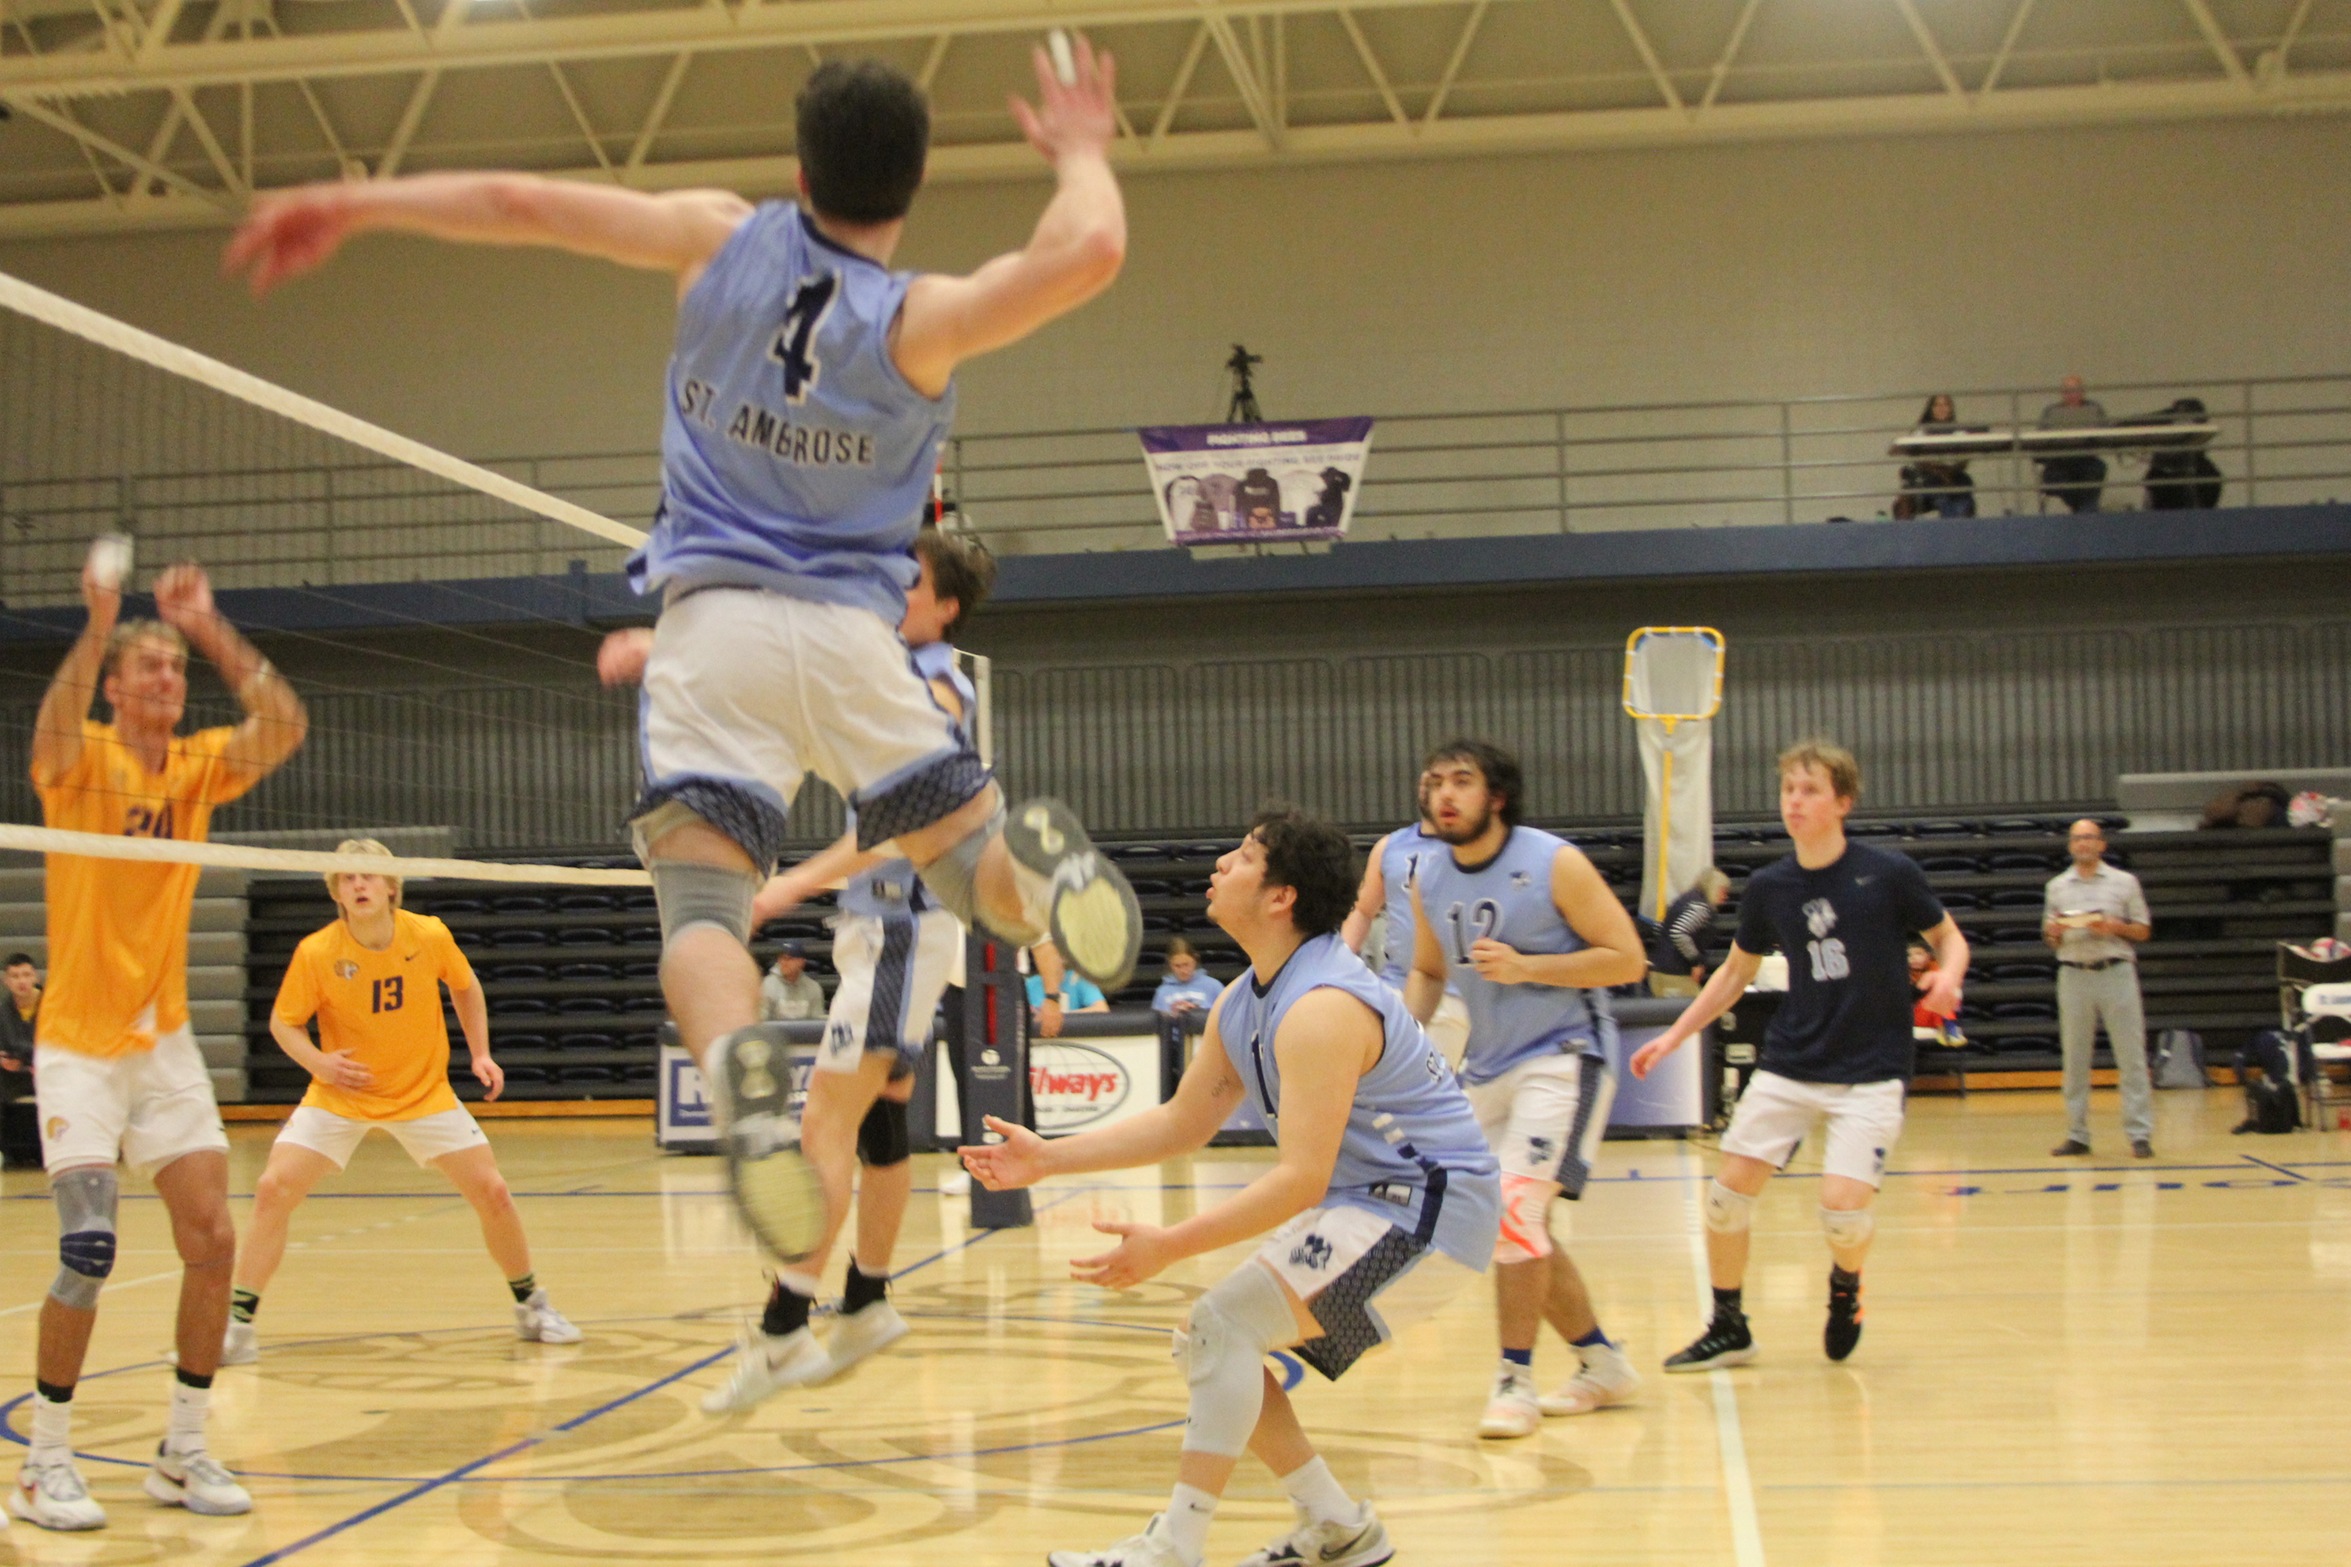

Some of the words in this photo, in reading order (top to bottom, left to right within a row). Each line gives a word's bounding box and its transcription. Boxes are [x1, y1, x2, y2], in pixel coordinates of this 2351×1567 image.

[680, 379, 717, 429] ST.
[727, 403, 876, 467] AMBROSE
[1806, 937, 1851, 982] 16
[372, 975, 403, 1014] 13
